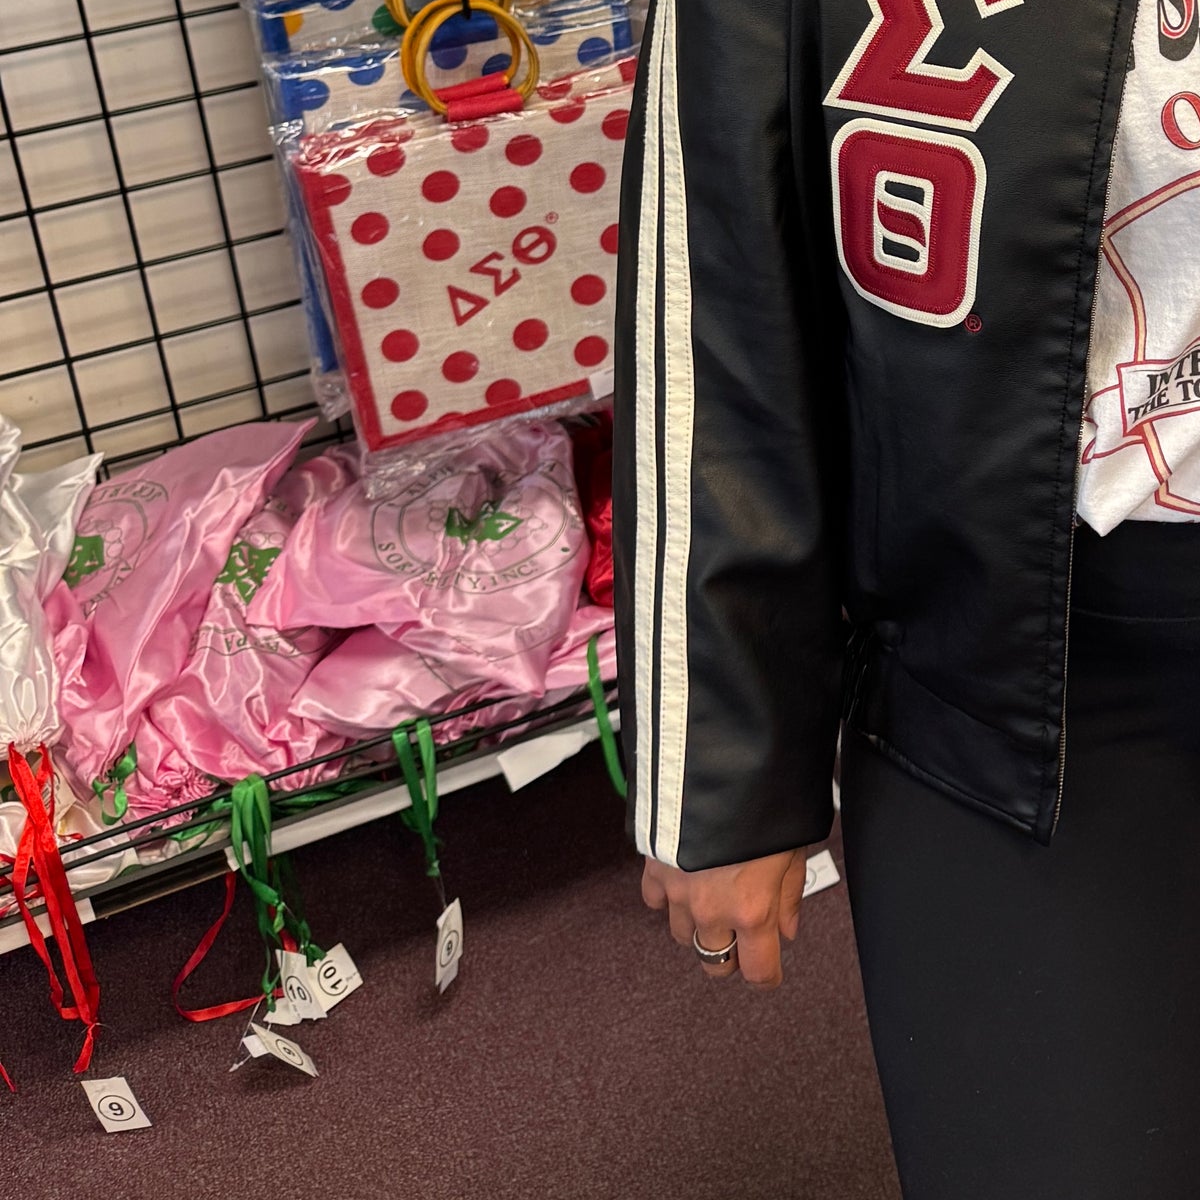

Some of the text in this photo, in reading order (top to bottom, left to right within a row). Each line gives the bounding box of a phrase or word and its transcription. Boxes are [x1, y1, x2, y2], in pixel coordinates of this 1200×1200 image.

[1128, 389, 1171, 424] THE
[323, 966, 342, 990] 10
[289, 983, 307, 1001] 10
[109, 1102, 124, 1117] 9
